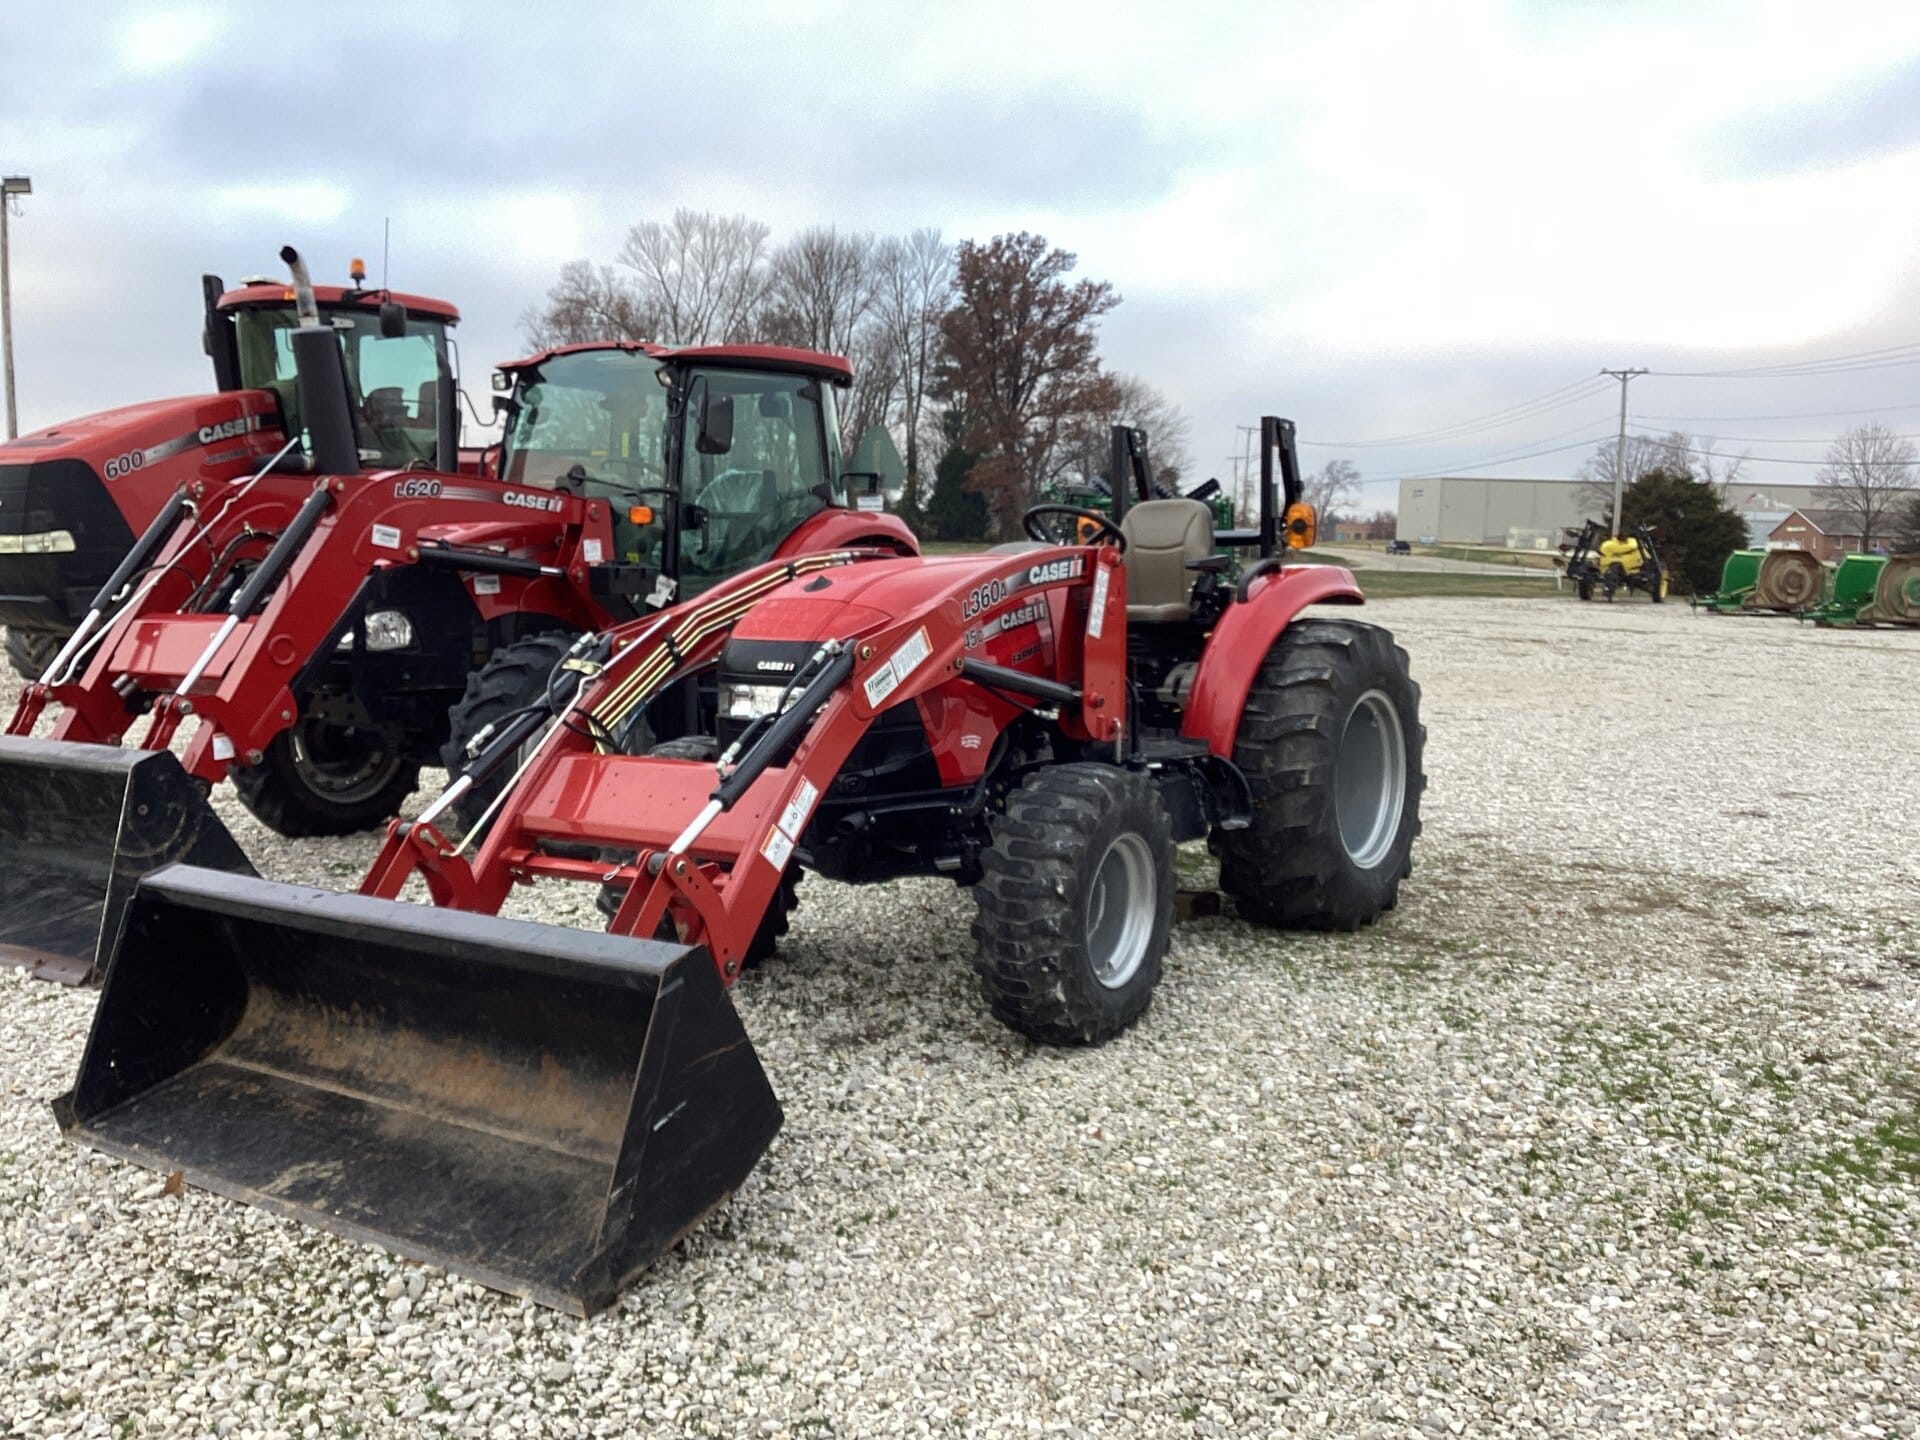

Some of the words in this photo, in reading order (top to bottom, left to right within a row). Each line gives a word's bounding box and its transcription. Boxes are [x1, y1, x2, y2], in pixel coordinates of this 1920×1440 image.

[198, 420, 246, 444] CASE
[104, 449, 145, 481] 600
[395, 479, 441, 498] L620
[503, 492, 548, 511] CASE
[1029, 561, 1068, 585] CASE
[962, 578, 1009, 622] L360A
[1000, 606, 1034, 630] CASE
[757, 661, 784, 671] CASE
